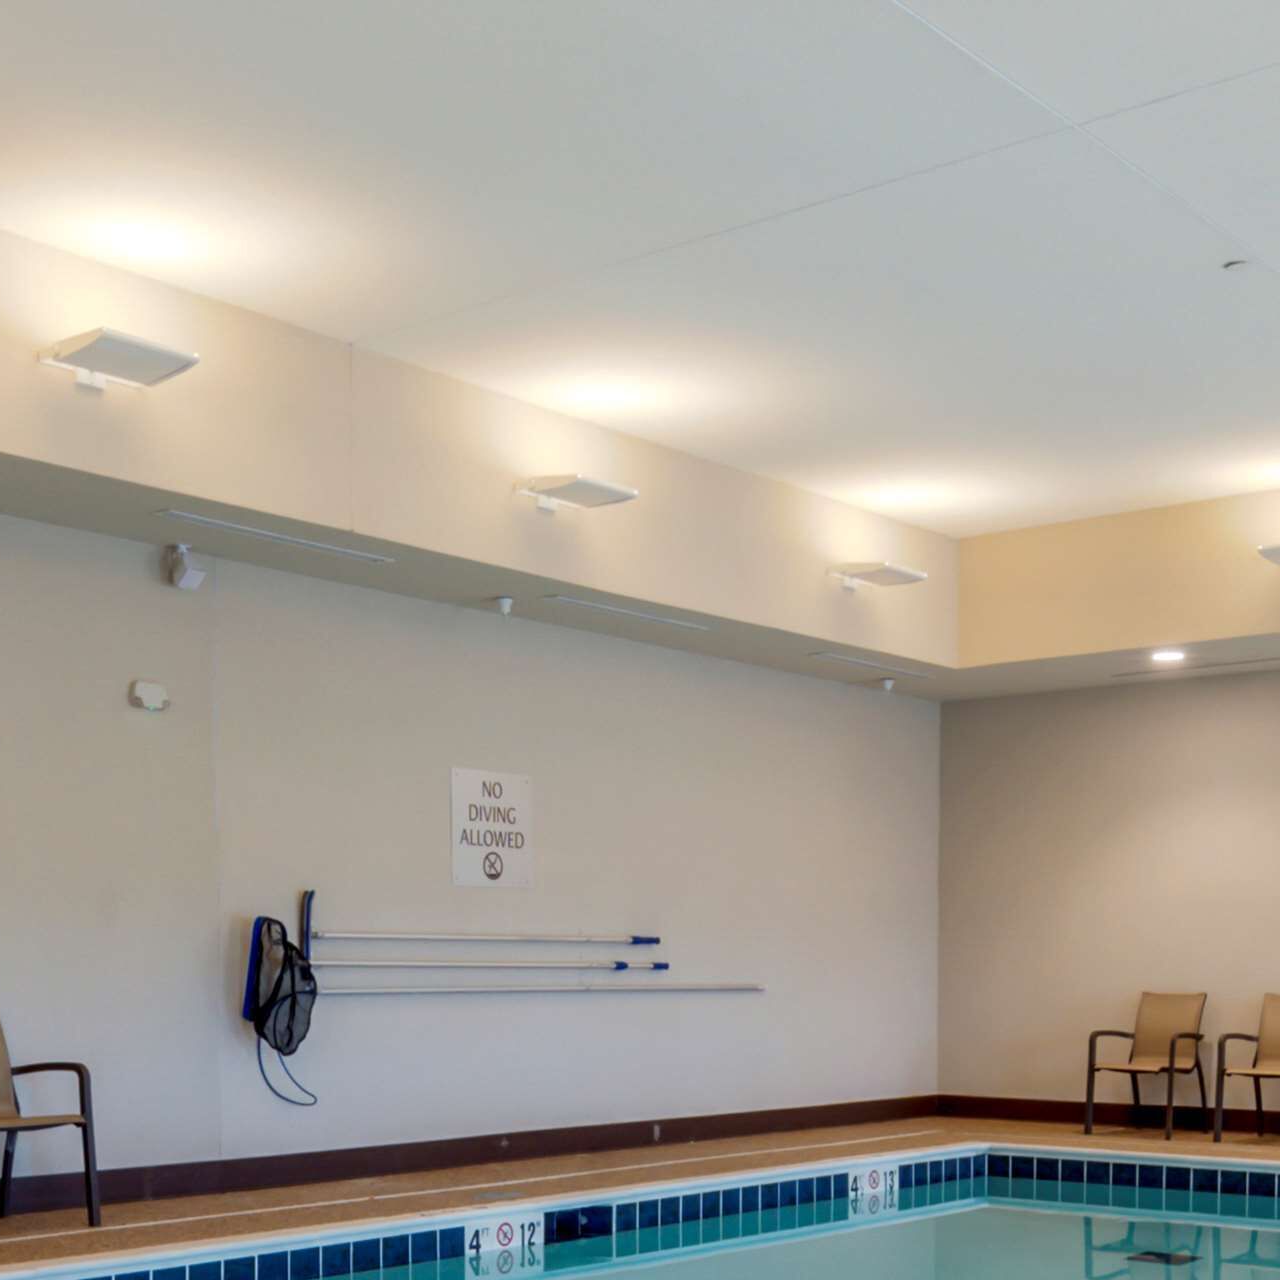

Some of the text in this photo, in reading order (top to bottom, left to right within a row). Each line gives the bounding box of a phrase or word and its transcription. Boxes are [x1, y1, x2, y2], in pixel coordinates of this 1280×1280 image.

[482, 780, 503, 799] NO
[468, 803, 517, 825] DIVING
[459, 828, 525, 849] ALLOWED
[469, 1229, 480, 1254] 4
[520, 1222, 536, 1247] 12
